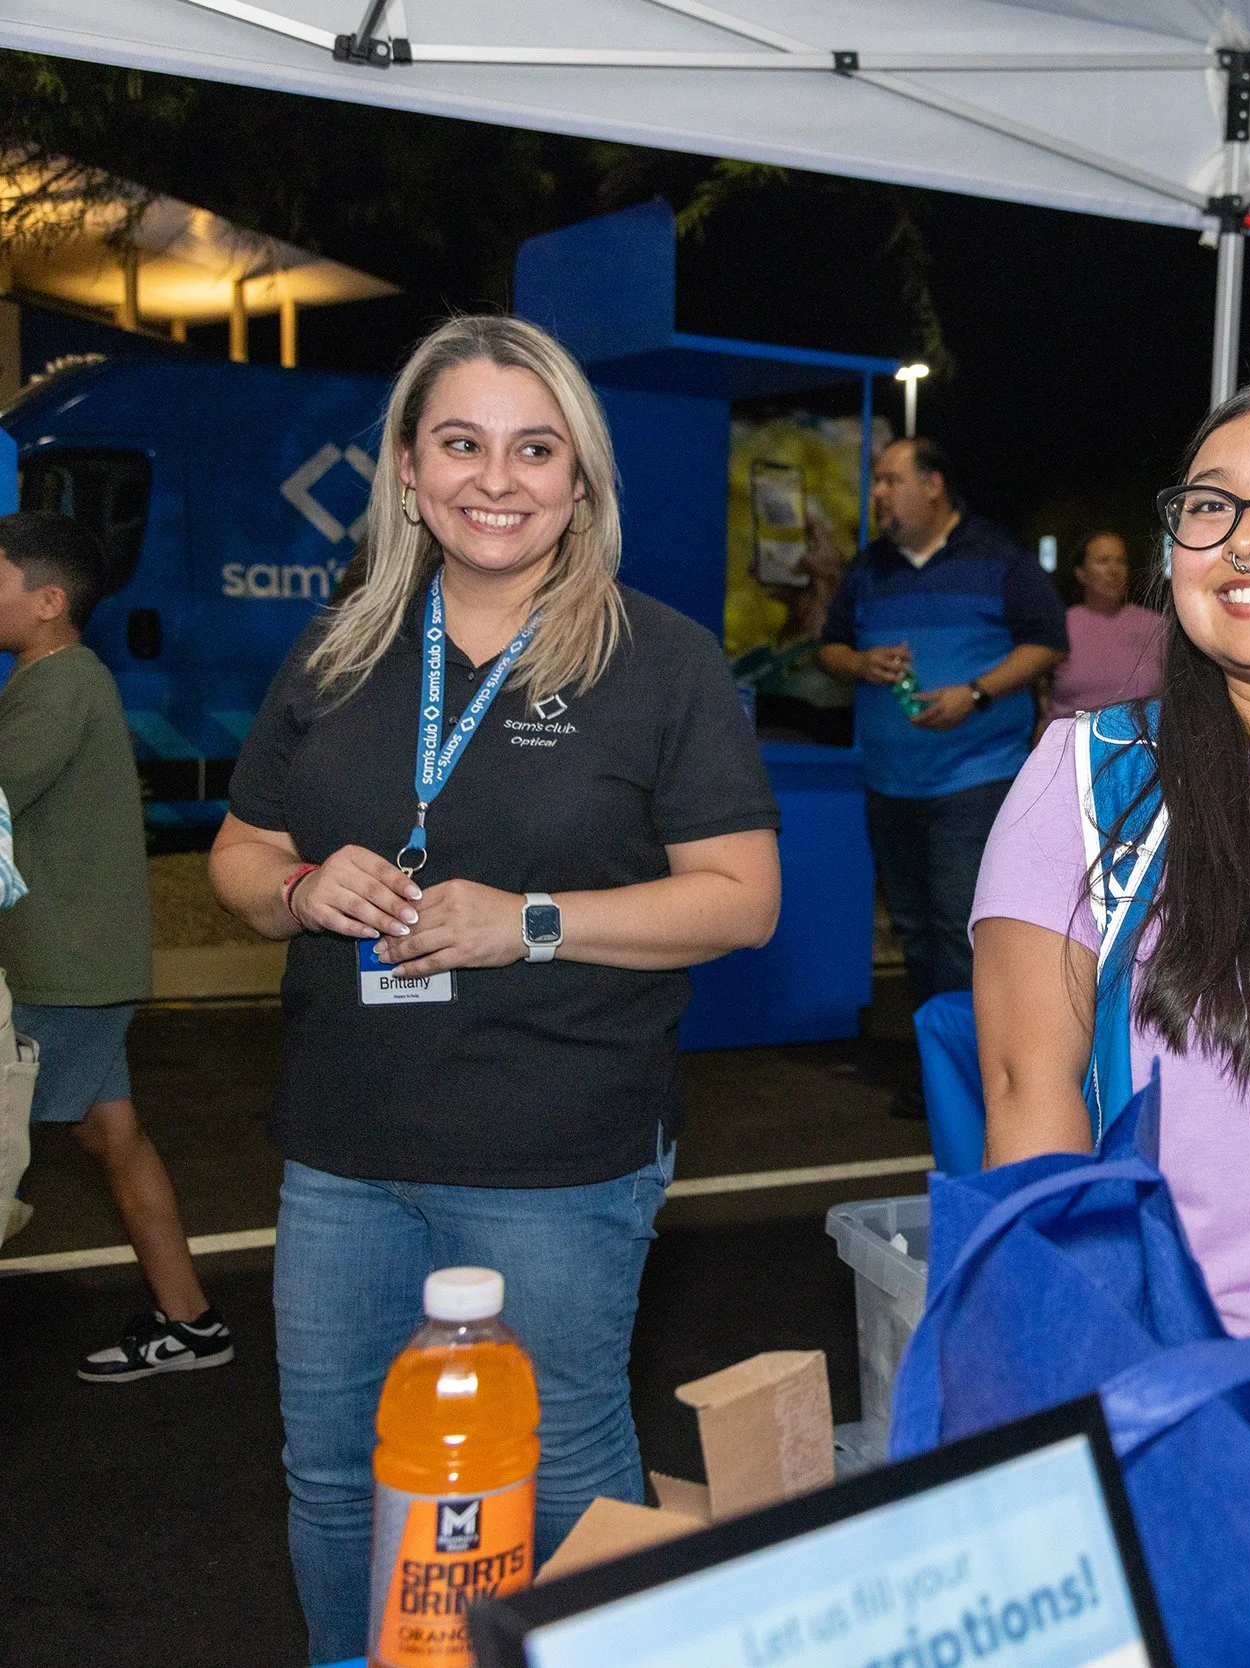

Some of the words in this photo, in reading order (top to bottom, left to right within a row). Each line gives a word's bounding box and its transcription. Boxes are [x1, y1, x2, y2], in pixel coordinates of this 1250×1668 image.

[433, 645, 441, 670] club
[487, 656, 511, 688] sam's
[430, 670, 441, 702] sam's
[471, 688, 491, 714] club
[426, 723, 439, 749] club
[503, 719, 544, 732] sam's
[440, 734, 463, 767] sam's
[510, 736, 557, 747] Optical
[422, 749, 436, 785] sam's
[380, 976, 431, 990] Brittany
[402, 1543, 525, 1588] SPORTS
